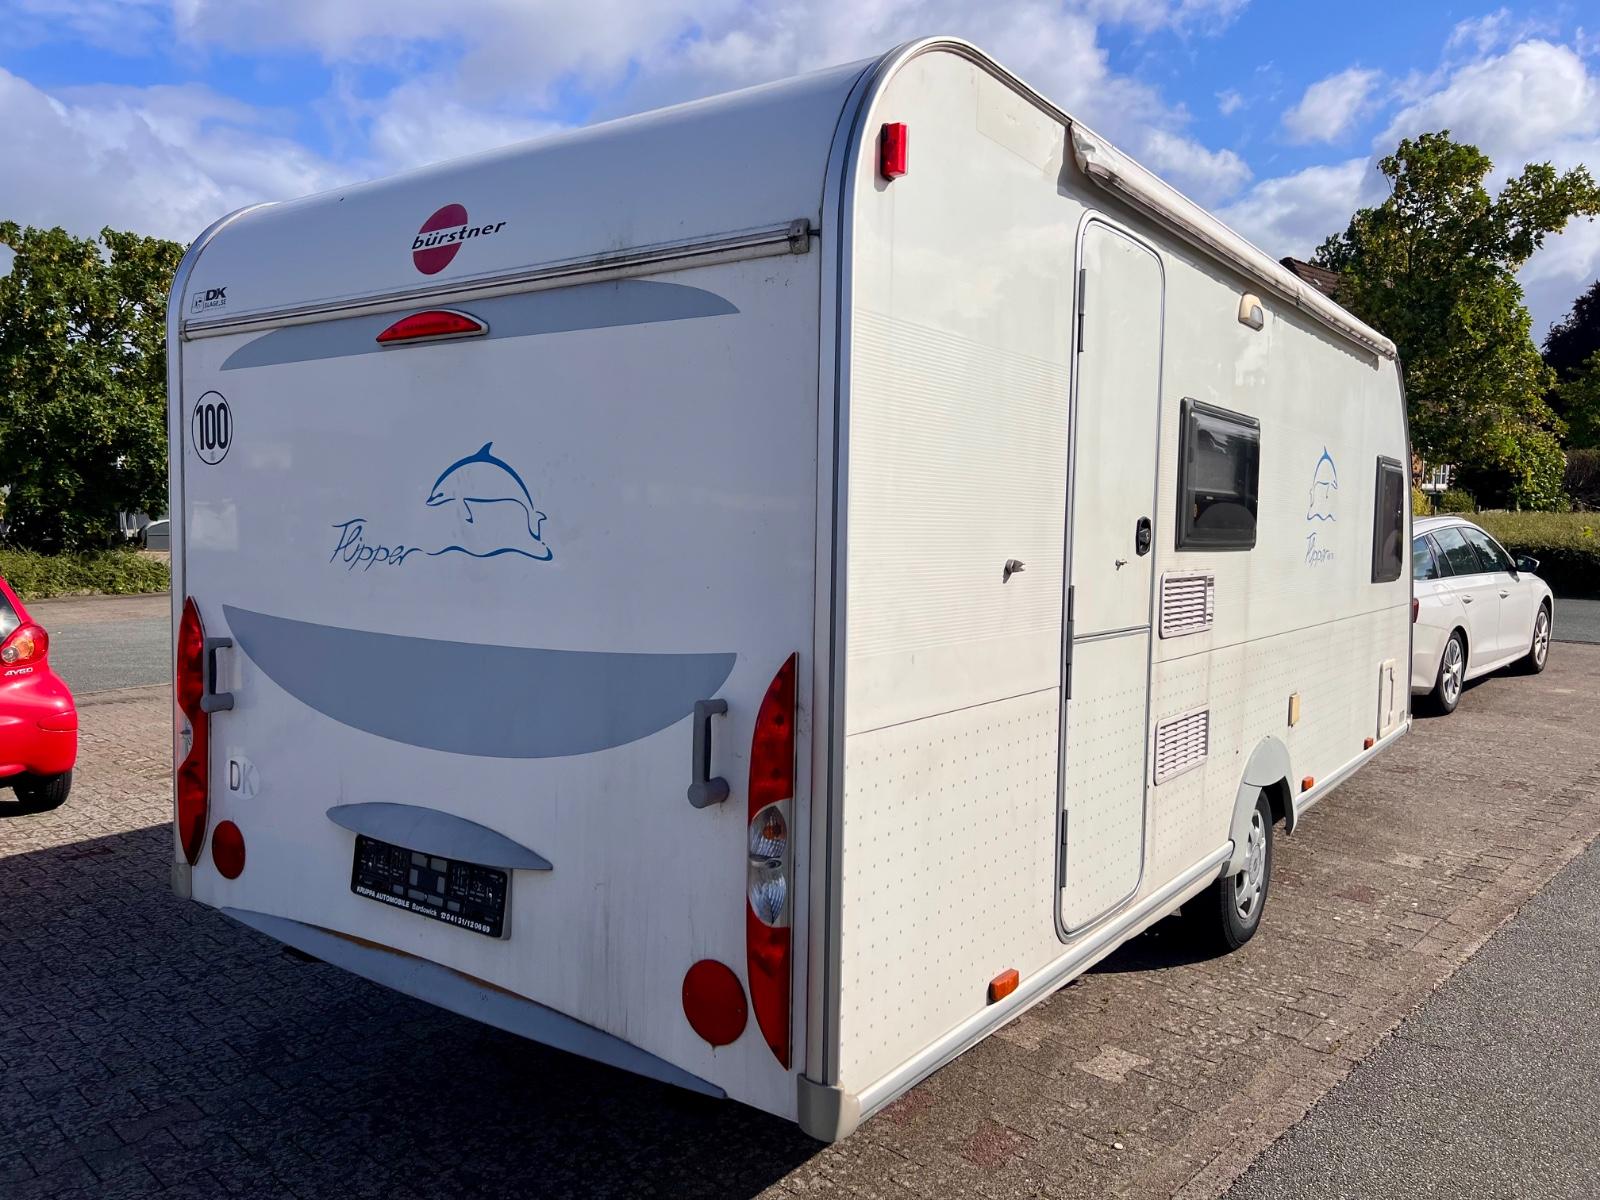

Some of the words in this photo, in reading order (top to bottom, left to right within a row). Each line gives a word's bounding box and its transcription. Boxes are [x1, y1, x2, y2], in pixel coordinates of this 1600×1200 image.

[411, 221, 507, 250] bürstner
[205, 286, 228, 301] DK
[195, 402, 229, 451] 100
[329, 518, 423, 571] Flipper
[376, 892, 410, 908] AUTOMOBILE
